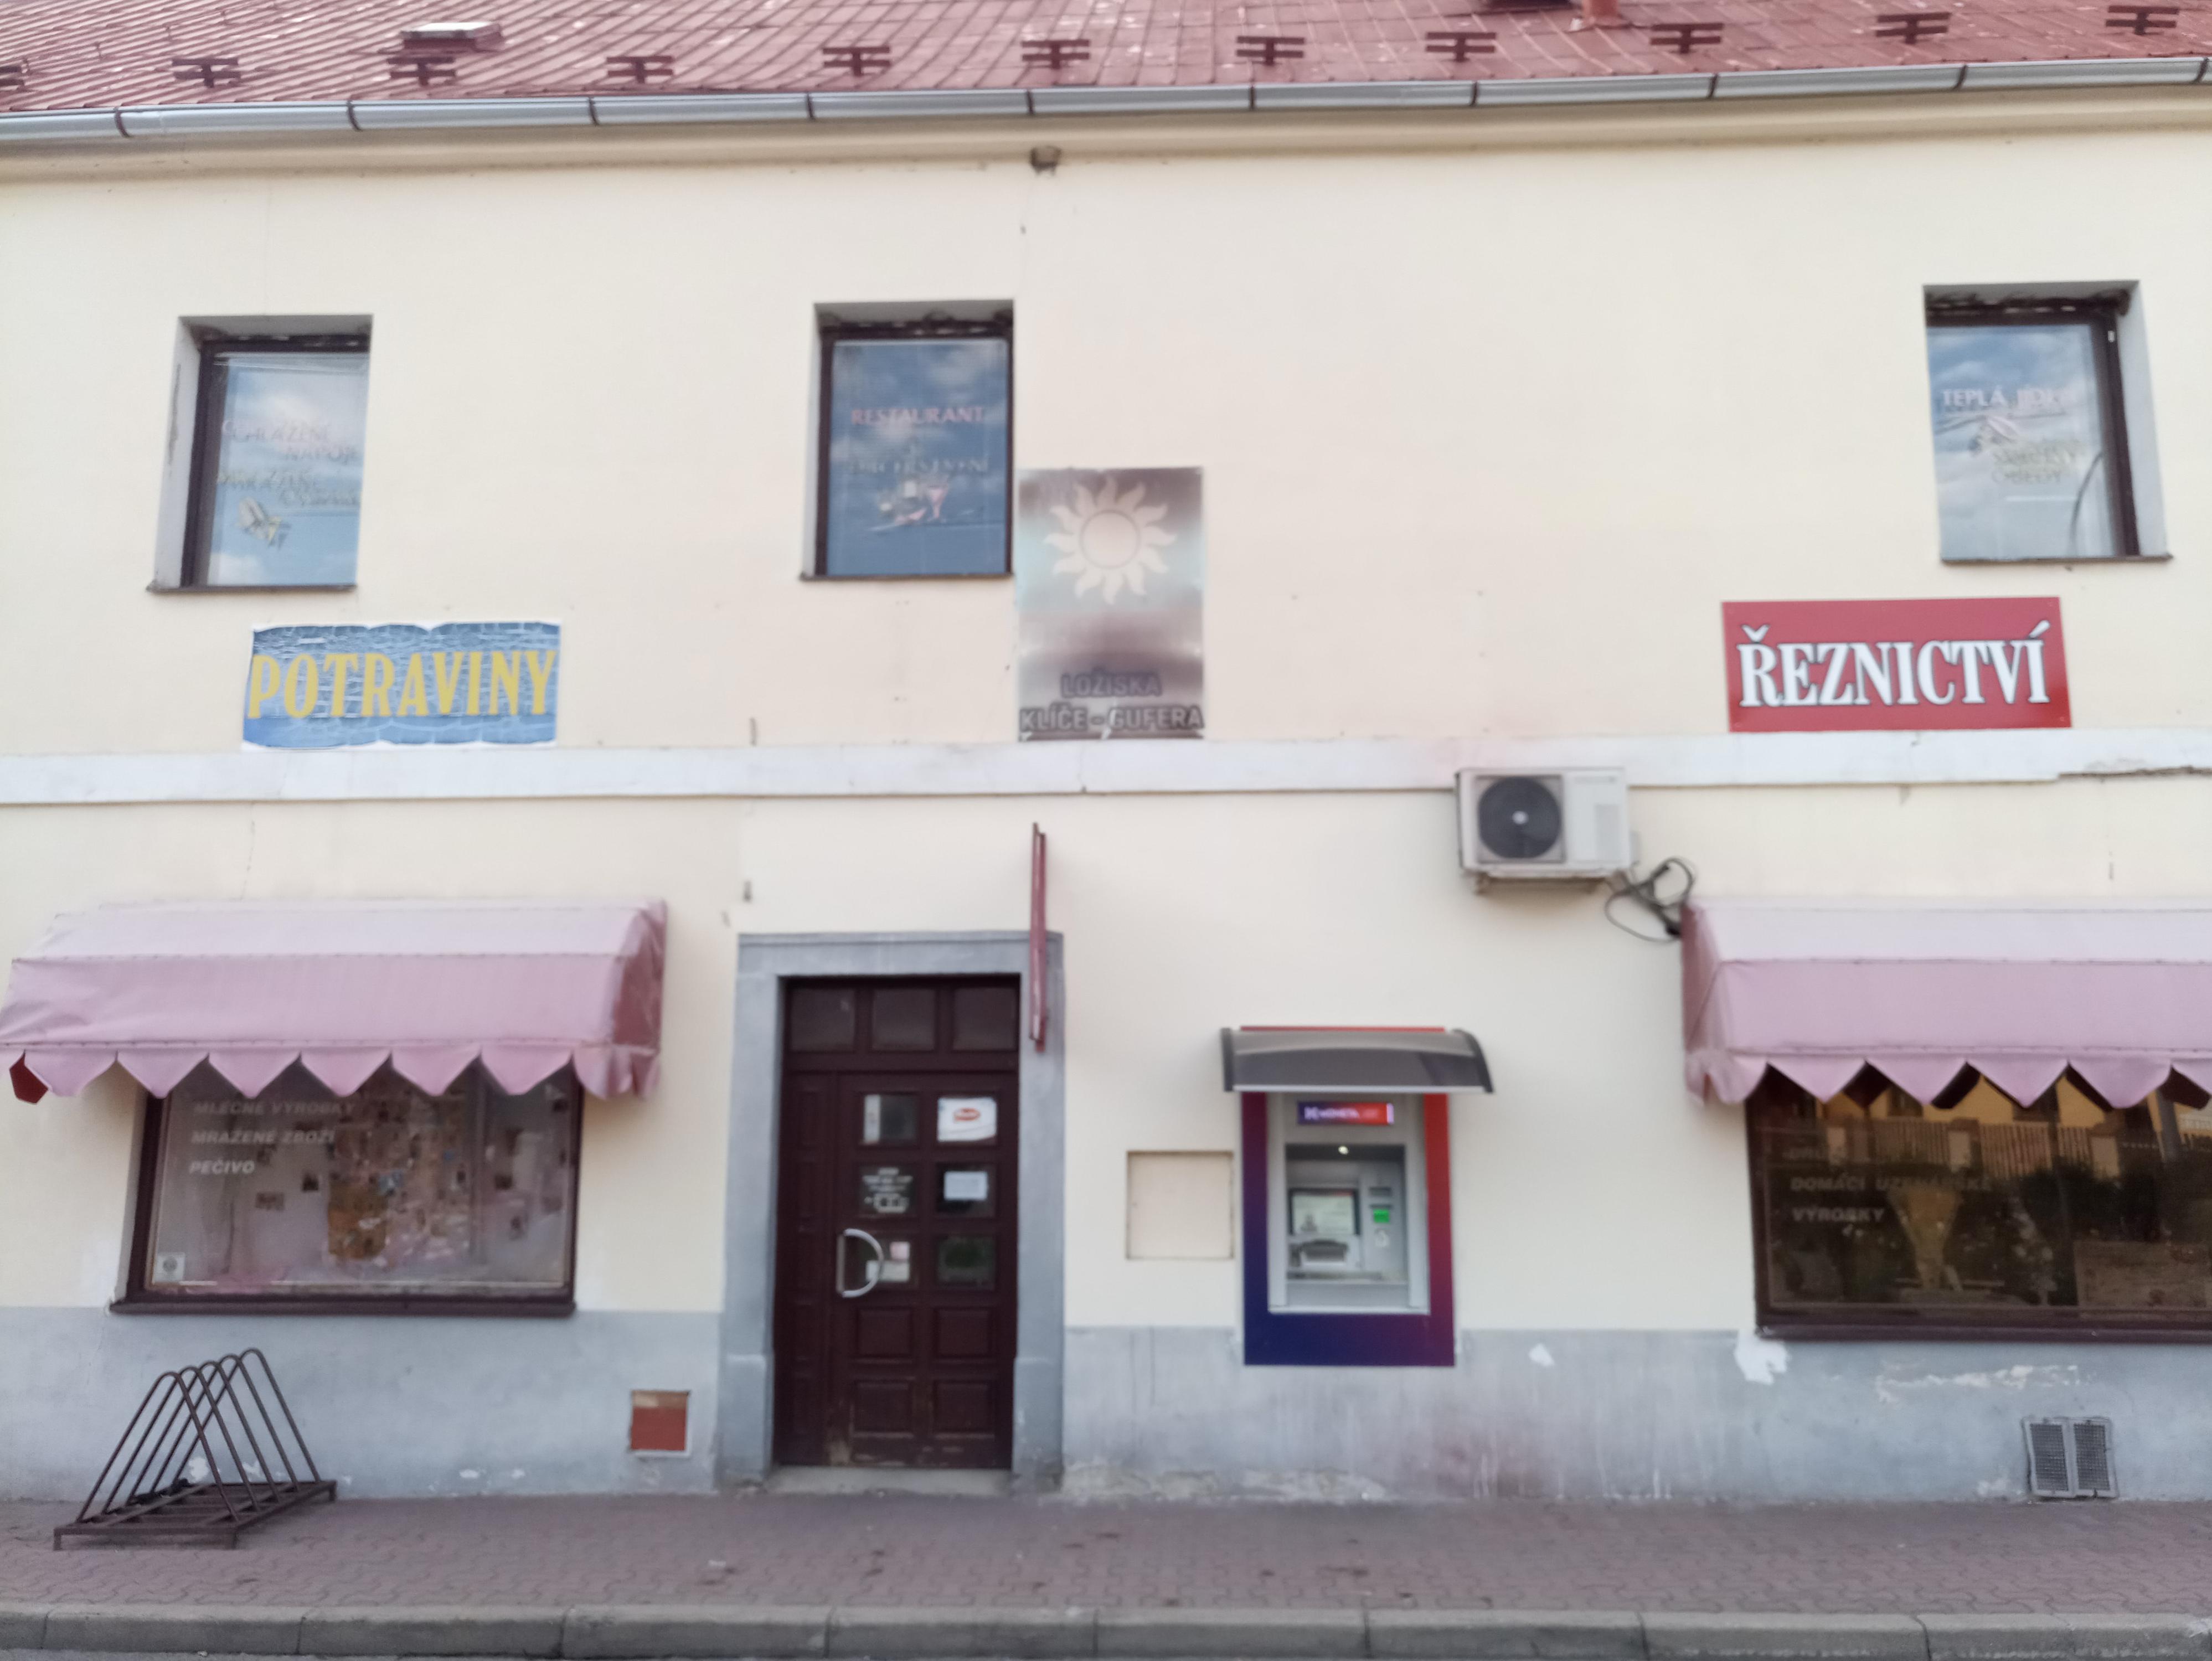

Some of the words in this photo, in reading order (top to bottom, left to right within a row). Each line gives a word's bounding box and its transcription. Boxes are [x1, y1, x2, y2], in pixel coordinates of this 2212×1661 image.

[851, 406, 986, 425] RESTAURANT
[1737, 620, 2051, 707] ŘEZNICTVÍ
[248, 651, 556, 719] POTRAVINY
[1060, 667, 1163, 698] LOŽISKA
[189, 1158, 256, 1174] PEČIVO
